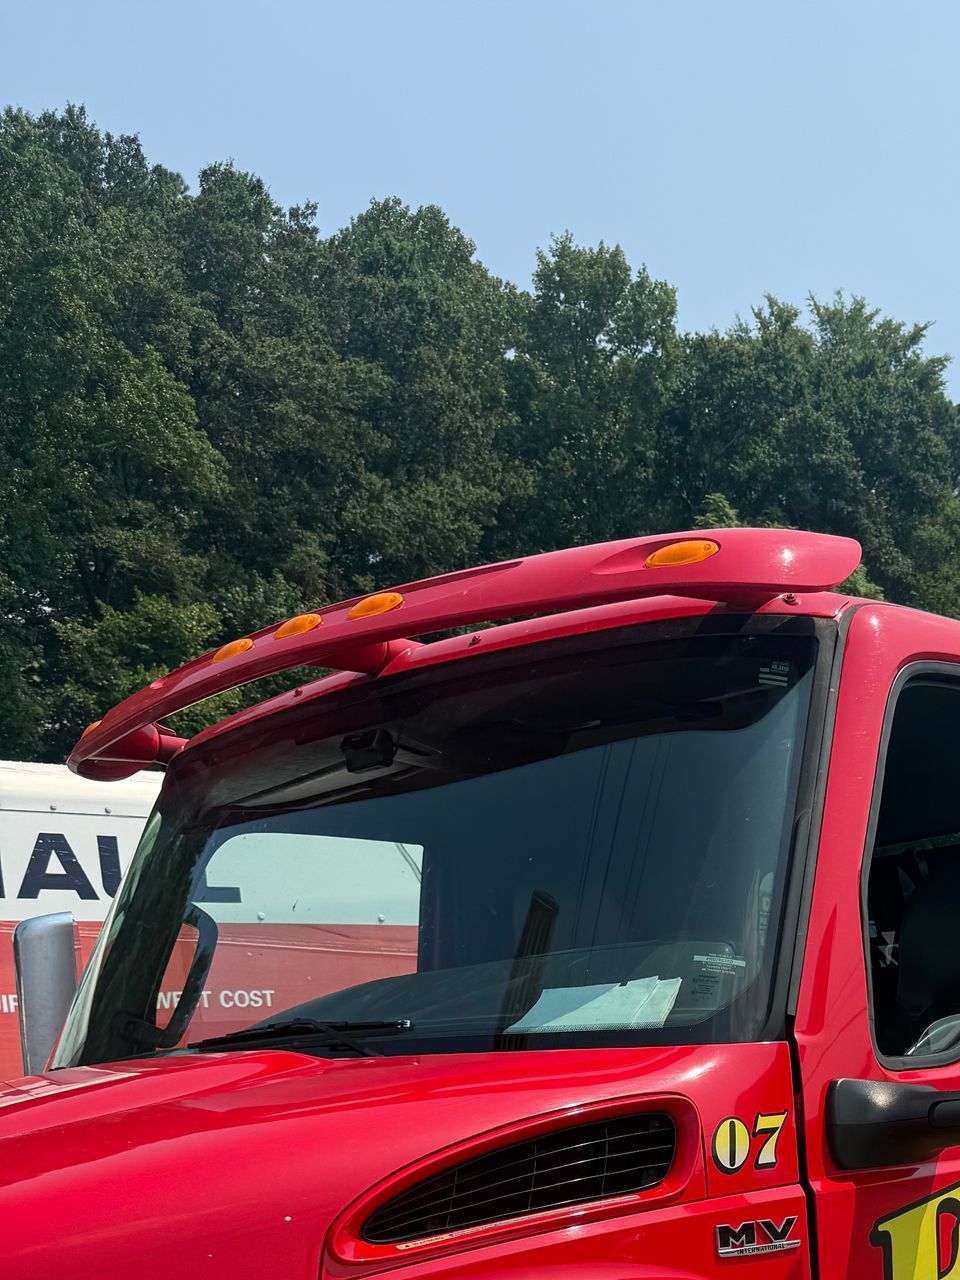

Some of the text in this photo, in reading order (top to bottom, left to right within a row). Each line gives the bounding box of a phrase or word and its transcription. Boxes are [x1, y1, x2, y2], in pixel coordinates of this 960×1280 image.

[219, 989, 275, 1008] COST
[712, 1110, 789, 1175] 07
[715, 1215, 799, 1251] MV
[736, 1242, 786, 1255] INTERNATIONAL
